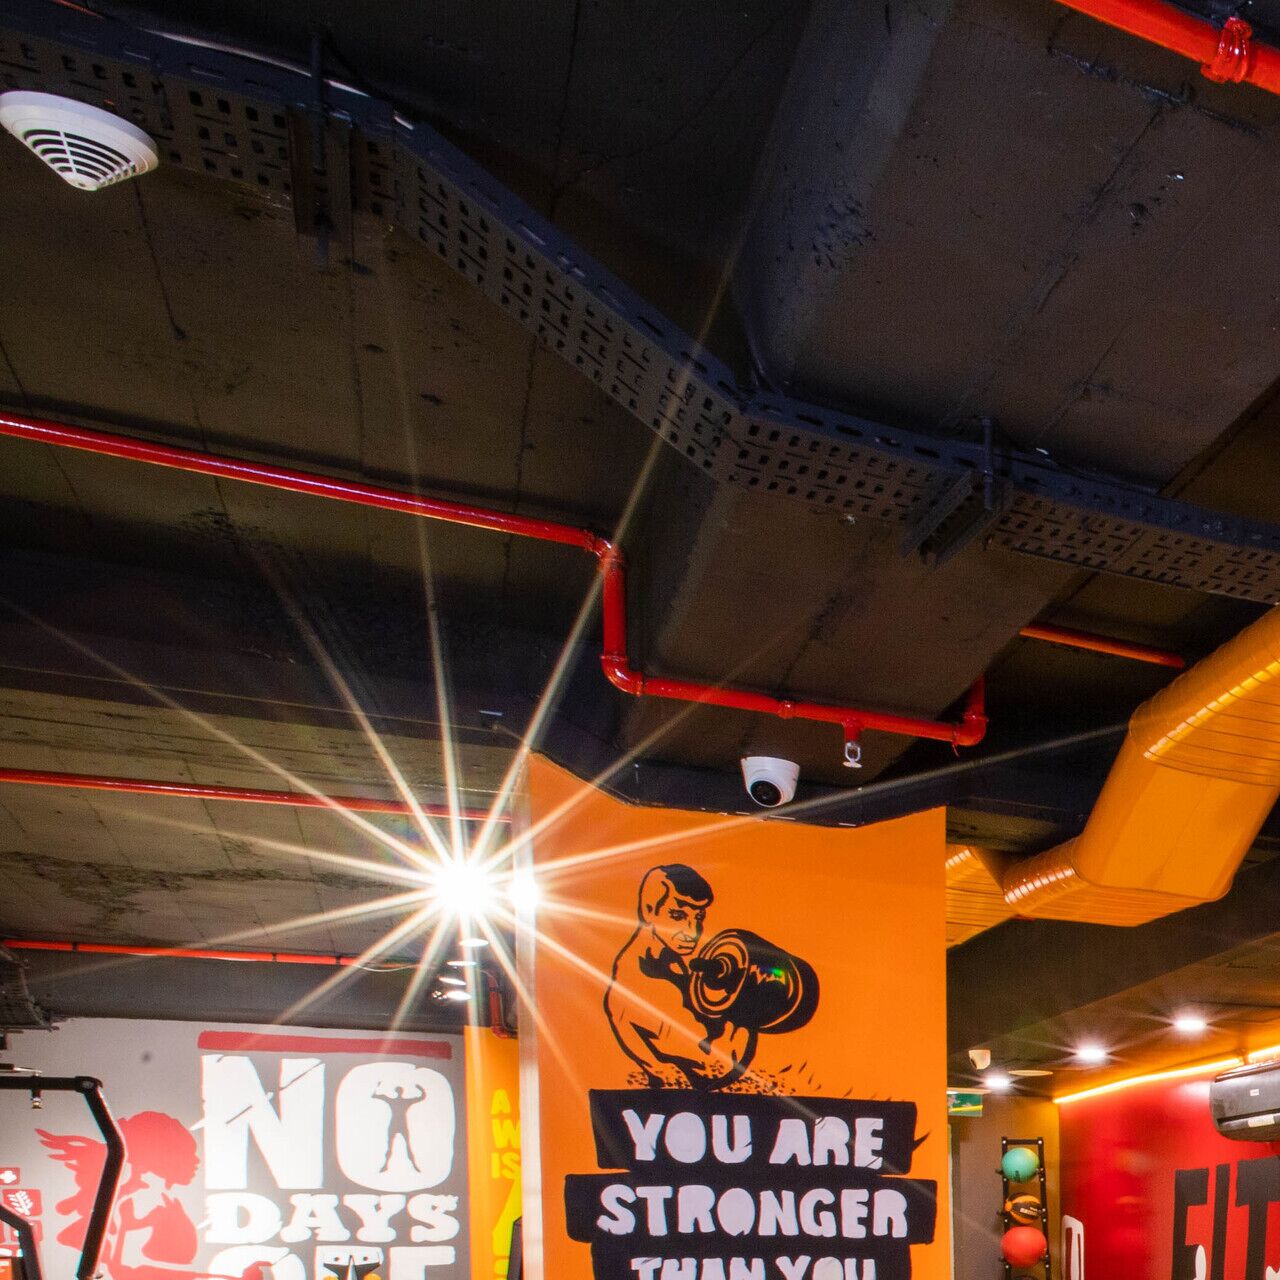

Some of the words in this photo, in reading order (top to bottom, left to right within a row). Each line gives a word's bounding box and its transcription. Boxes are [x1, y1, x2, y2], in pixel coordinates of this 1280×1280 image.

[199, 1054, 455, 1192] NO
[622, 1109, 752, 1163] YOU
[769, 1116, 884, 1169] ARE
[204, 1194, 459, 1243] DAYS
[597, 1185, 908, 1239] STRONGER
